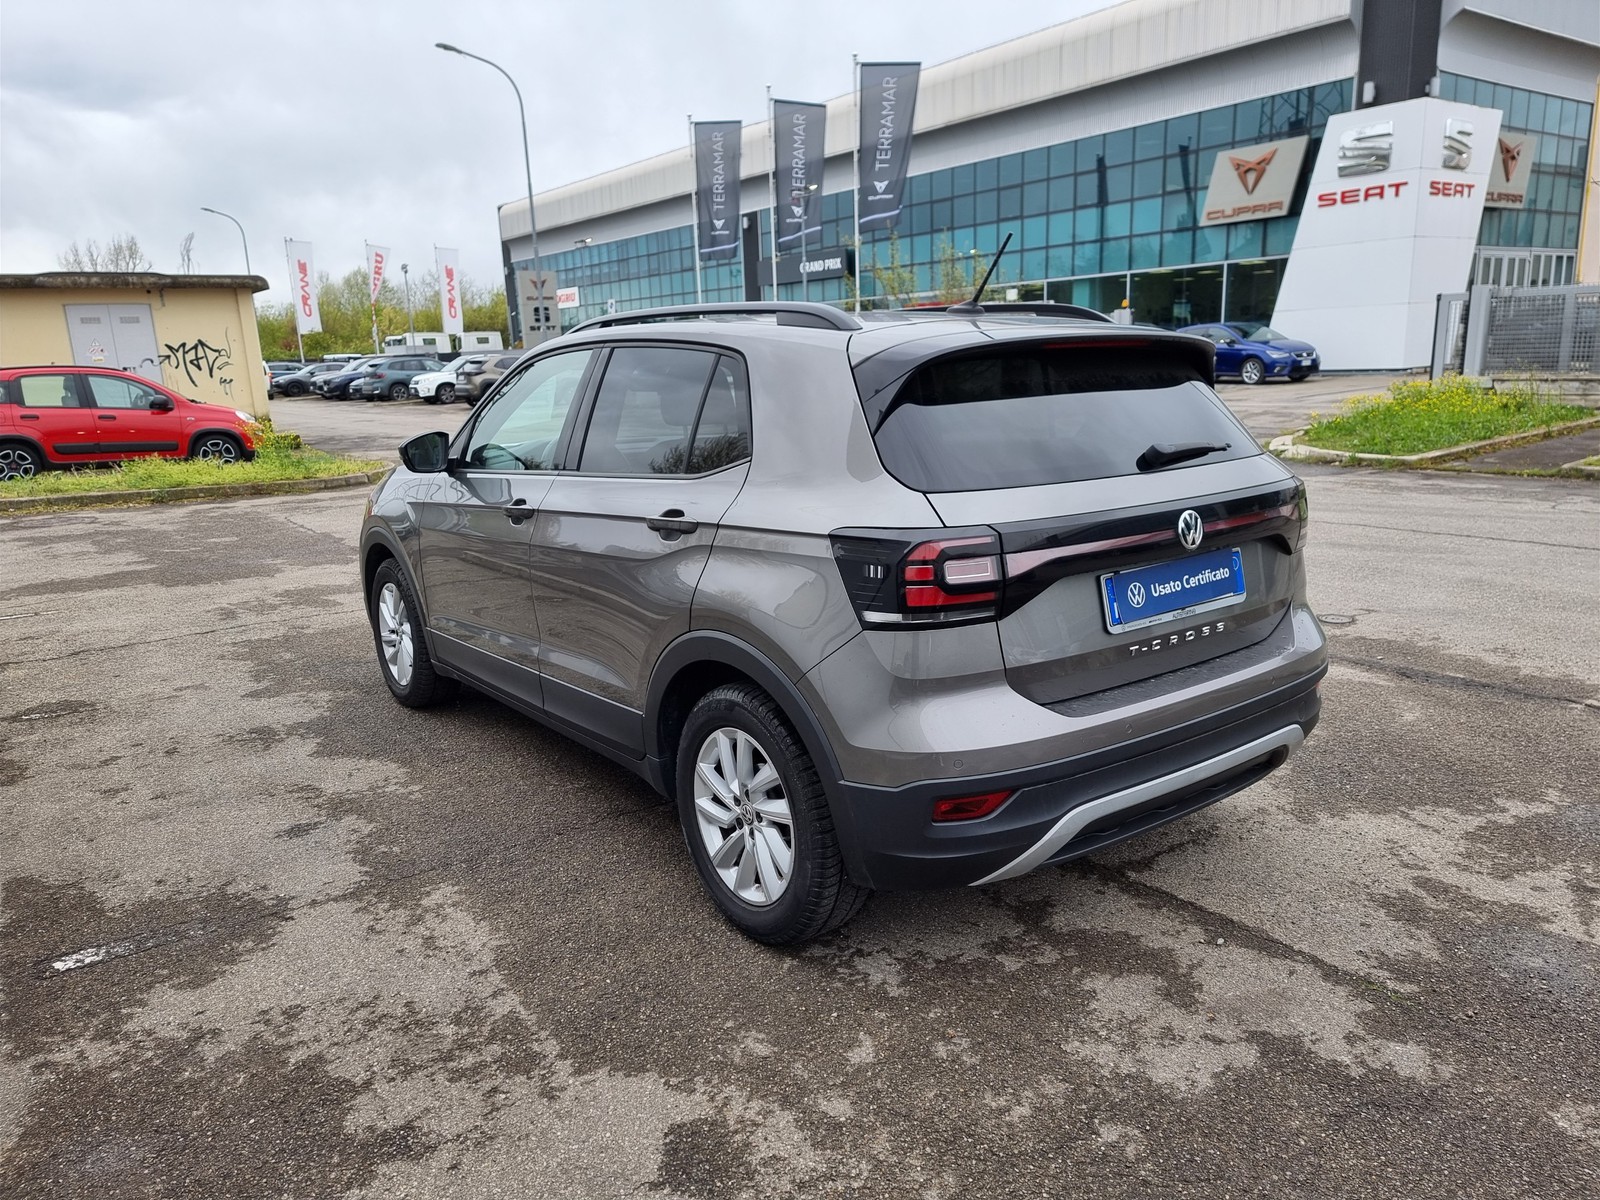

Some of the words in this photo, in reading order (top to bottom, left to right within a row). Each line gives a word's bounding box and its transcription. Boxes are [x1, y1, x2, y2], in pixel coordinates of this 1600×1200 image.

[875, 76, 898, 171] TERRAMAR
[791, 113, 807, 198] TERRAMAR
[712, 131, 726, 212] TERRAMAR
[1317, 181, 1409, 208] SEAT
[1428, 180, 1475, 199] SEAT
[1485, 191, 1524, 204] CUPRA
[1206, 200, 1284, 220] CUPRA
[799, 260, 824, 273] GRAND
[824, 257, 842, 270] PRIX
[297, 259, 313, 317] CRANE
[444, 264, 457, 319] CRANE
[1150, 579, 1182, 597] Usato
[1183, 568, 1230, 588] Certificato
[1130, 623, 1225, 655] T-CROSS
